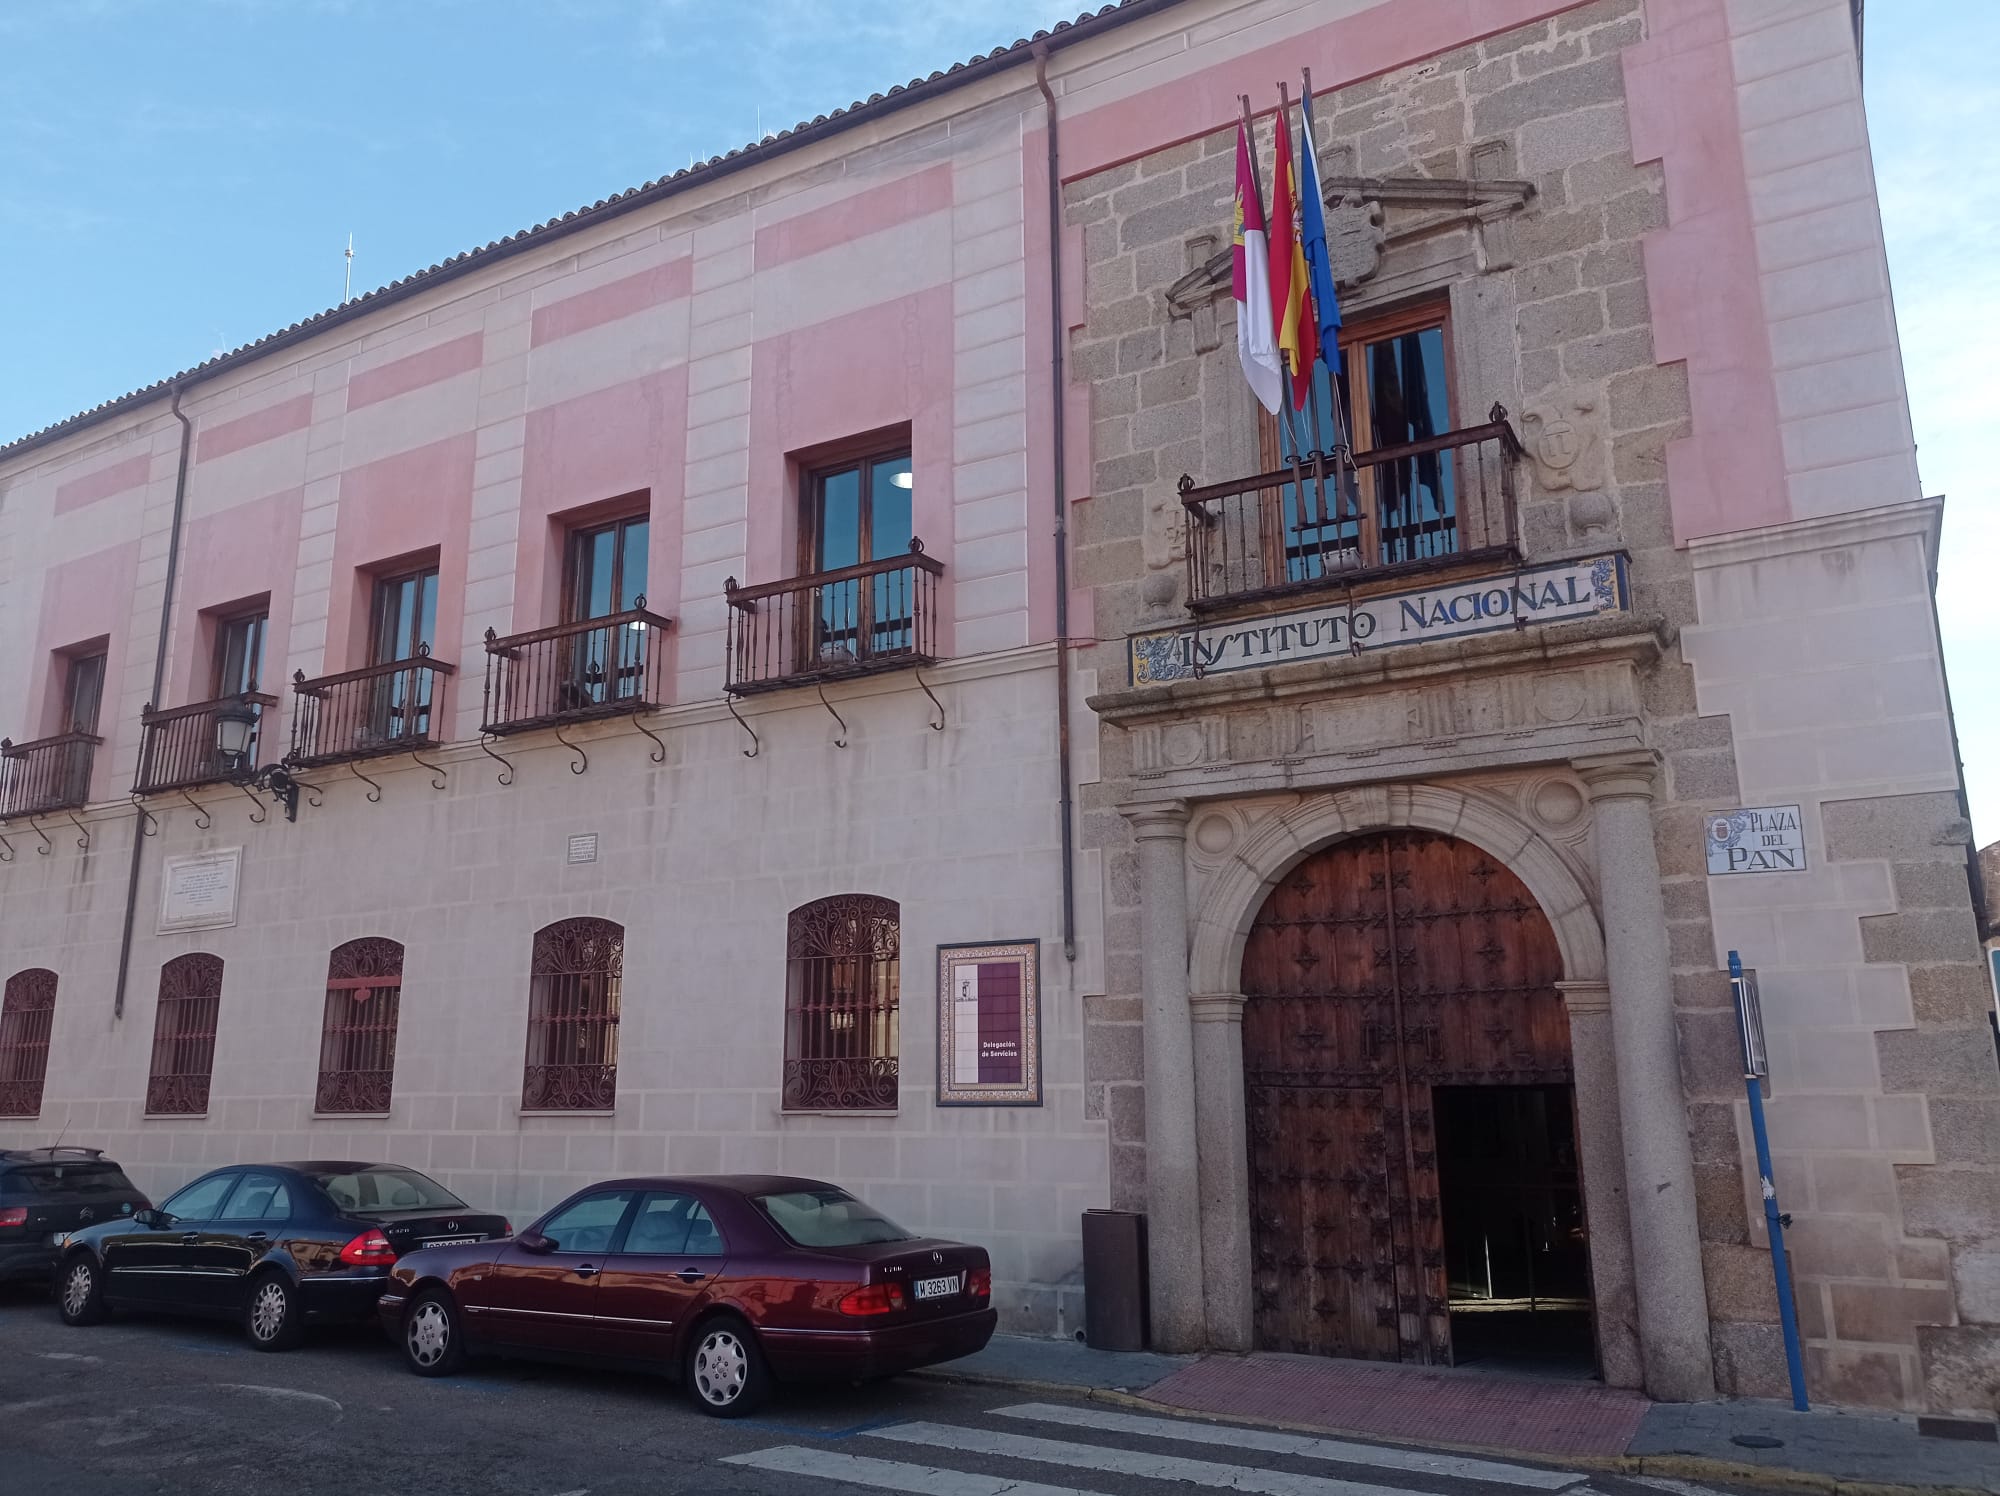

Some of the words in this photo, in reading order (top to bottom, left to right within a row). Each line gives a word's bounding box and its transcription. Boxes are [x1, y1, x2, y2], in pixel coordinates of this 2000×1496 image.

[1180, 612, 1377, 667] INSTITUTO
[1399, 576, 1591, 631] NACIONAL
[1750, 812, 1797, 832] PLAZA
[1762, 834, 1789, 846] DEL
[1726, 847, 1796, 871] PAN
[927, 1280, 946, 1295] 3263
